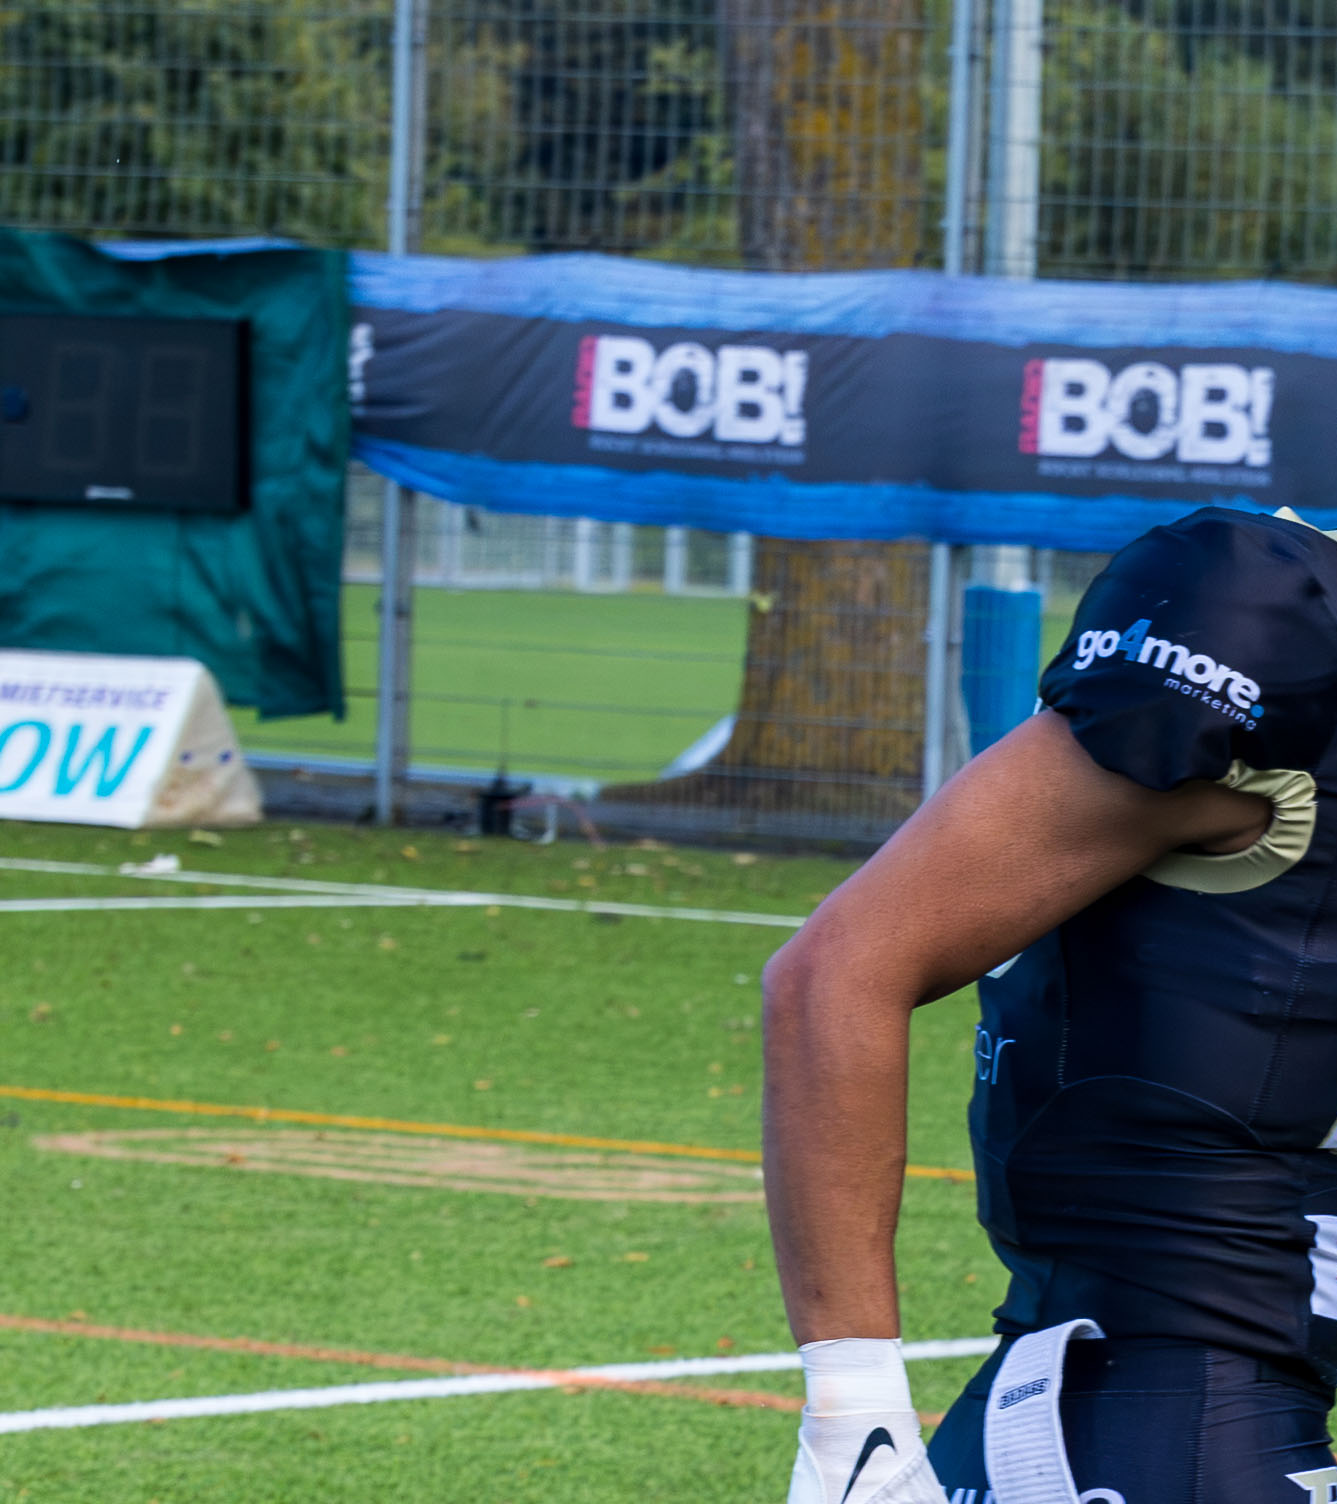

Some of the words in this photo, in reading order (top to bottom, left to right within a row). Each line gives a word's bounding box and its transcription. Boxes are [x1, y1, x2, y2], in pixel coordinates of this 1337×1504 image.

[588, 334, 808, 446] BOB!
[1037, 357, 1274, 466] BOB!
[1163, 677, 1257, 732] marketing
